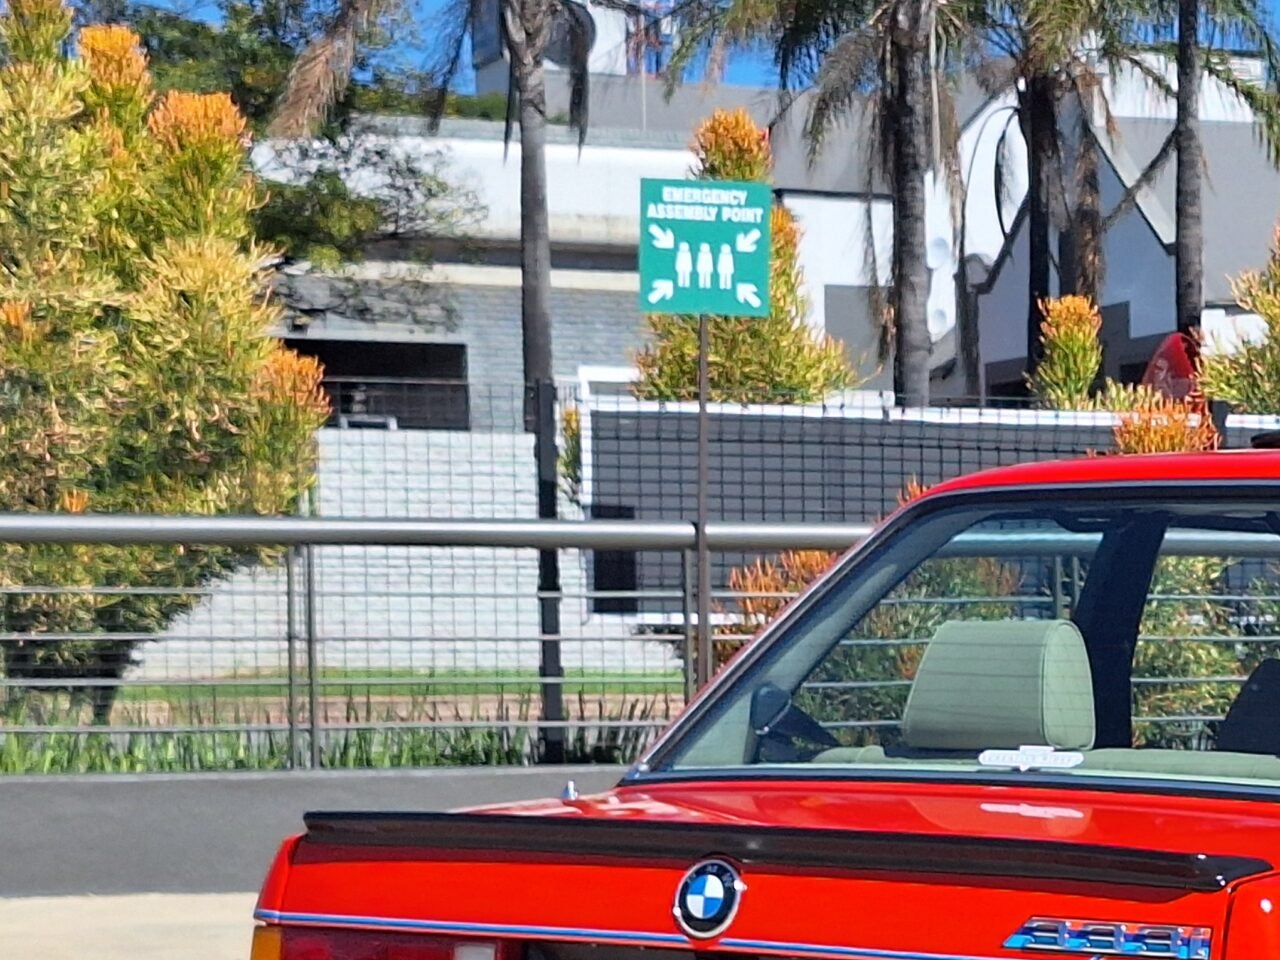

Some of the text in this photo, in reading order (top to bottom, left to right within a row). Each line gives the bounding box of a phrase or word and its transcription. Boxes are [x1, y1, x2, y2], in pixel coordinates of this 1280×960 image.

[662, 186, 748, 205] EMERGENCY
[647, 203, 764, 223] ASSEMBLY POINT
